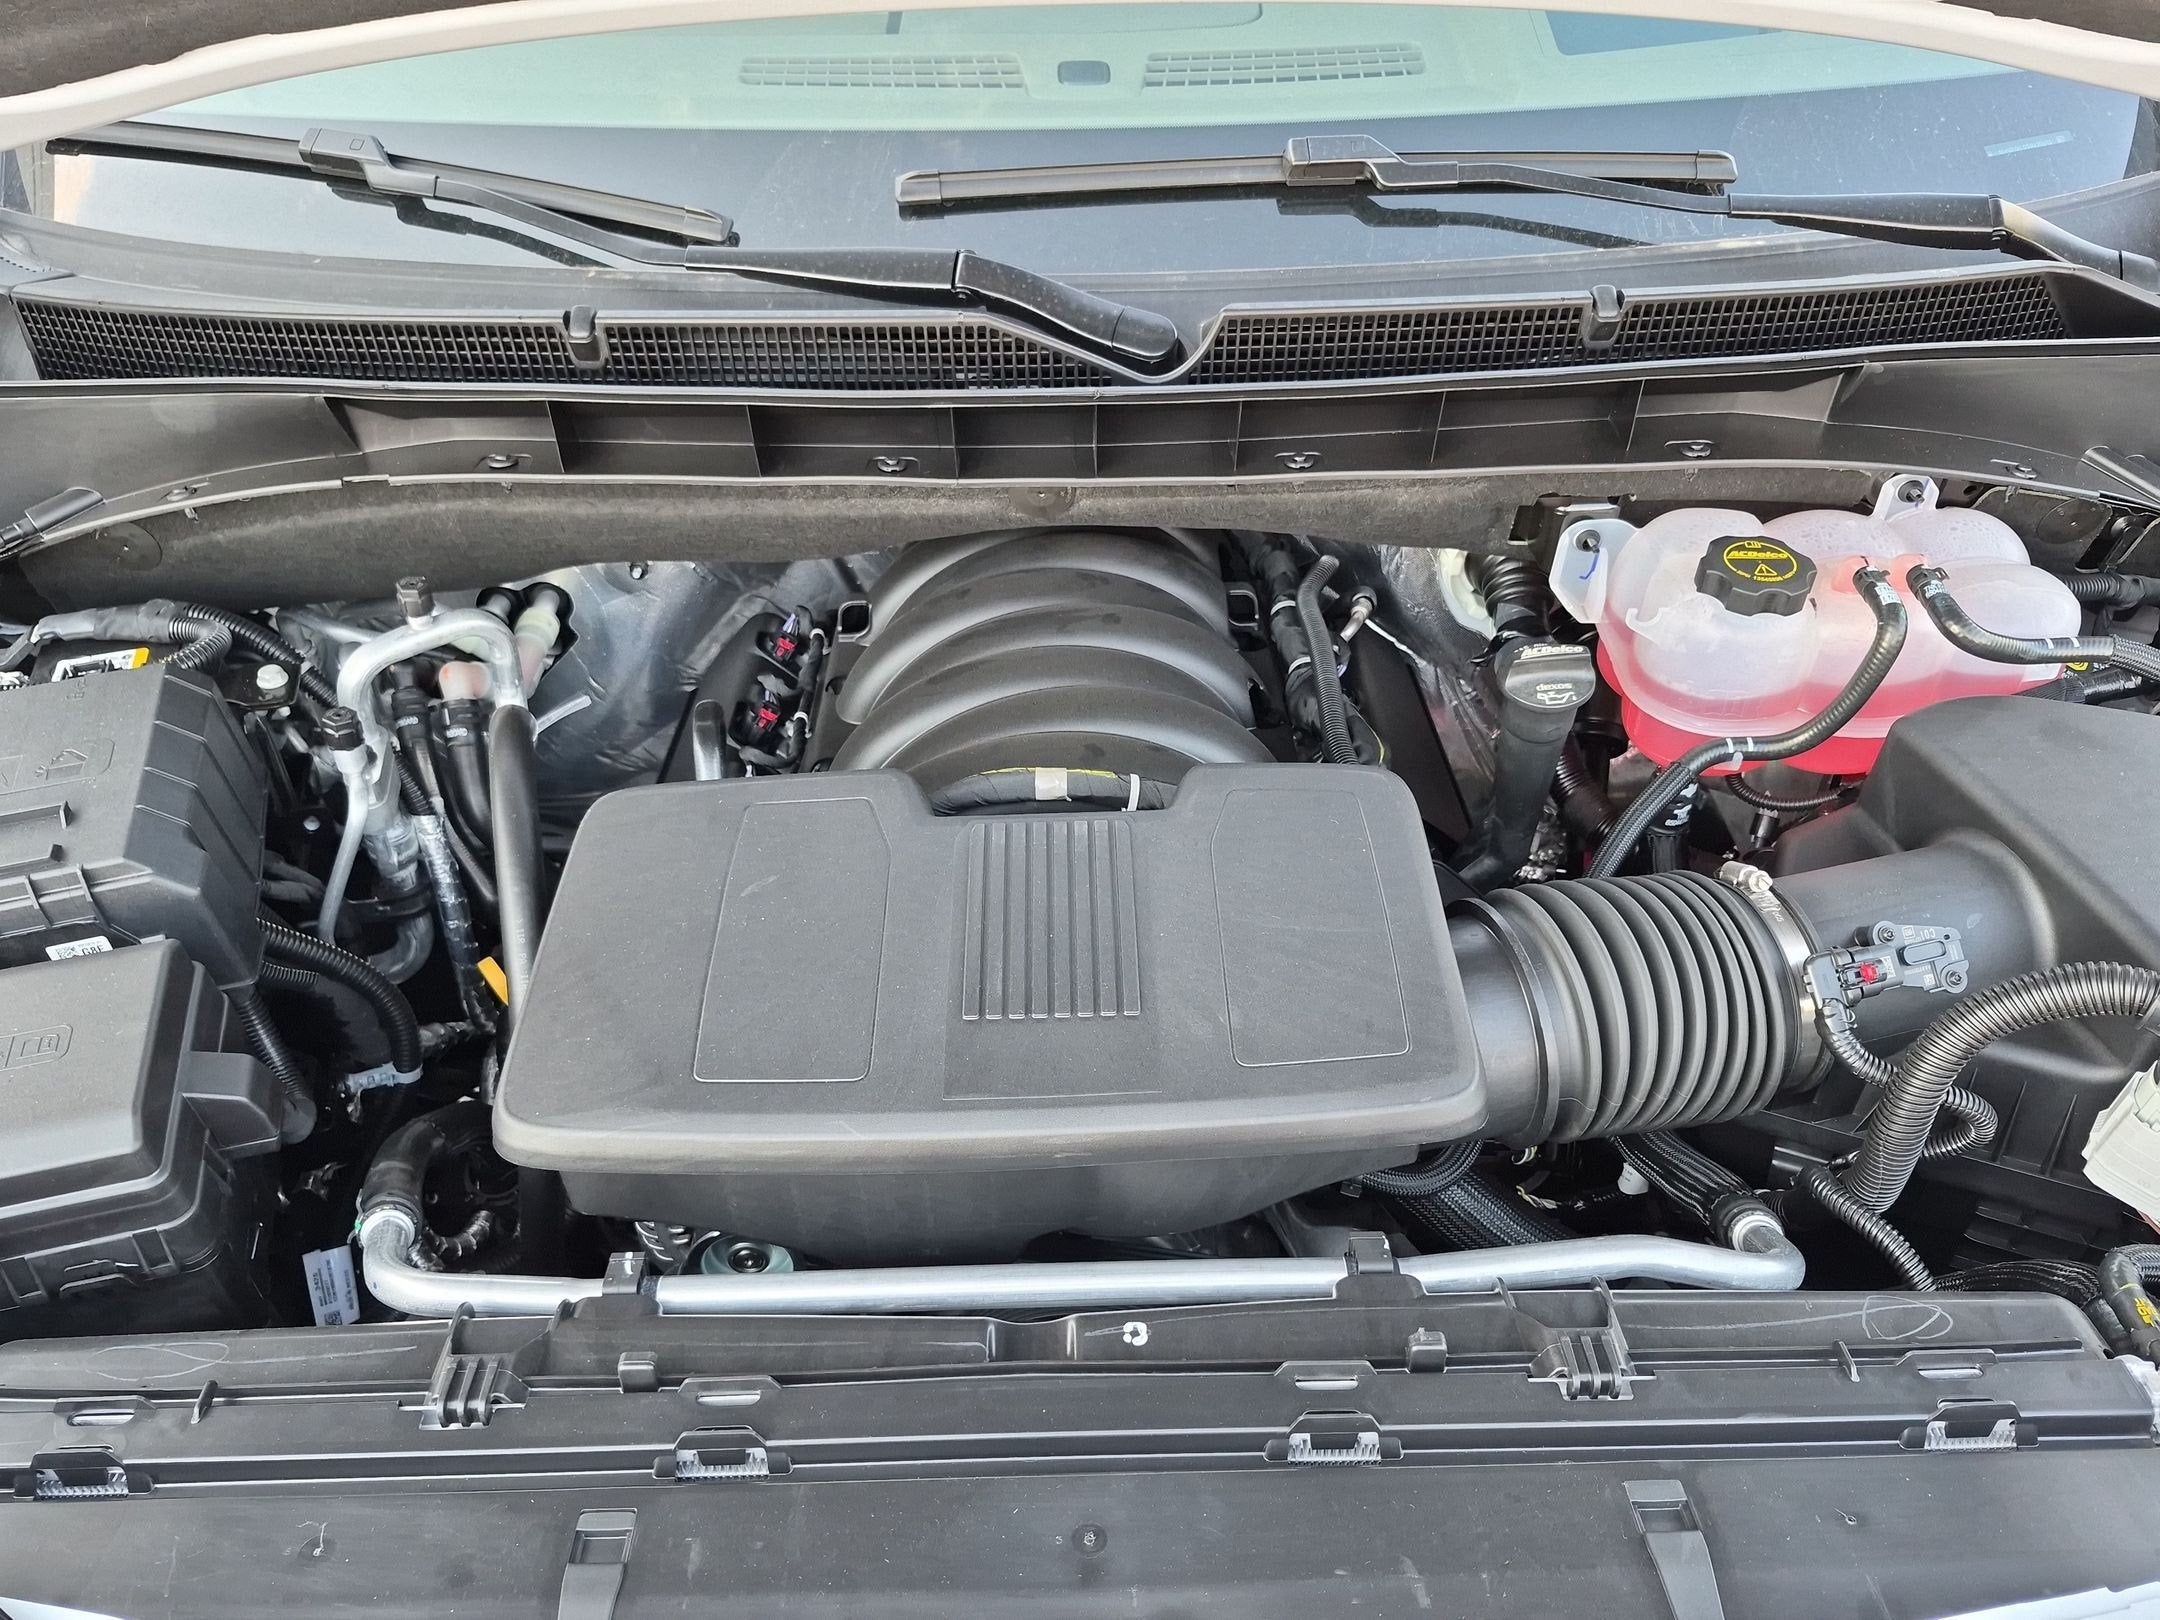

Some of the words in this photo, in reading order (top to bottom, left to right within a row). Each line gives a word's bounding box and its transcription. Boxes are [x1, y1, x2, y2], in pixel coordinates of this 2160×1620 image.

[1726, 550, 1788, 559] ACDelco
[1520, 645, 1584, 659] ACDelco
[1535, 683, 1573, 692] dexos
